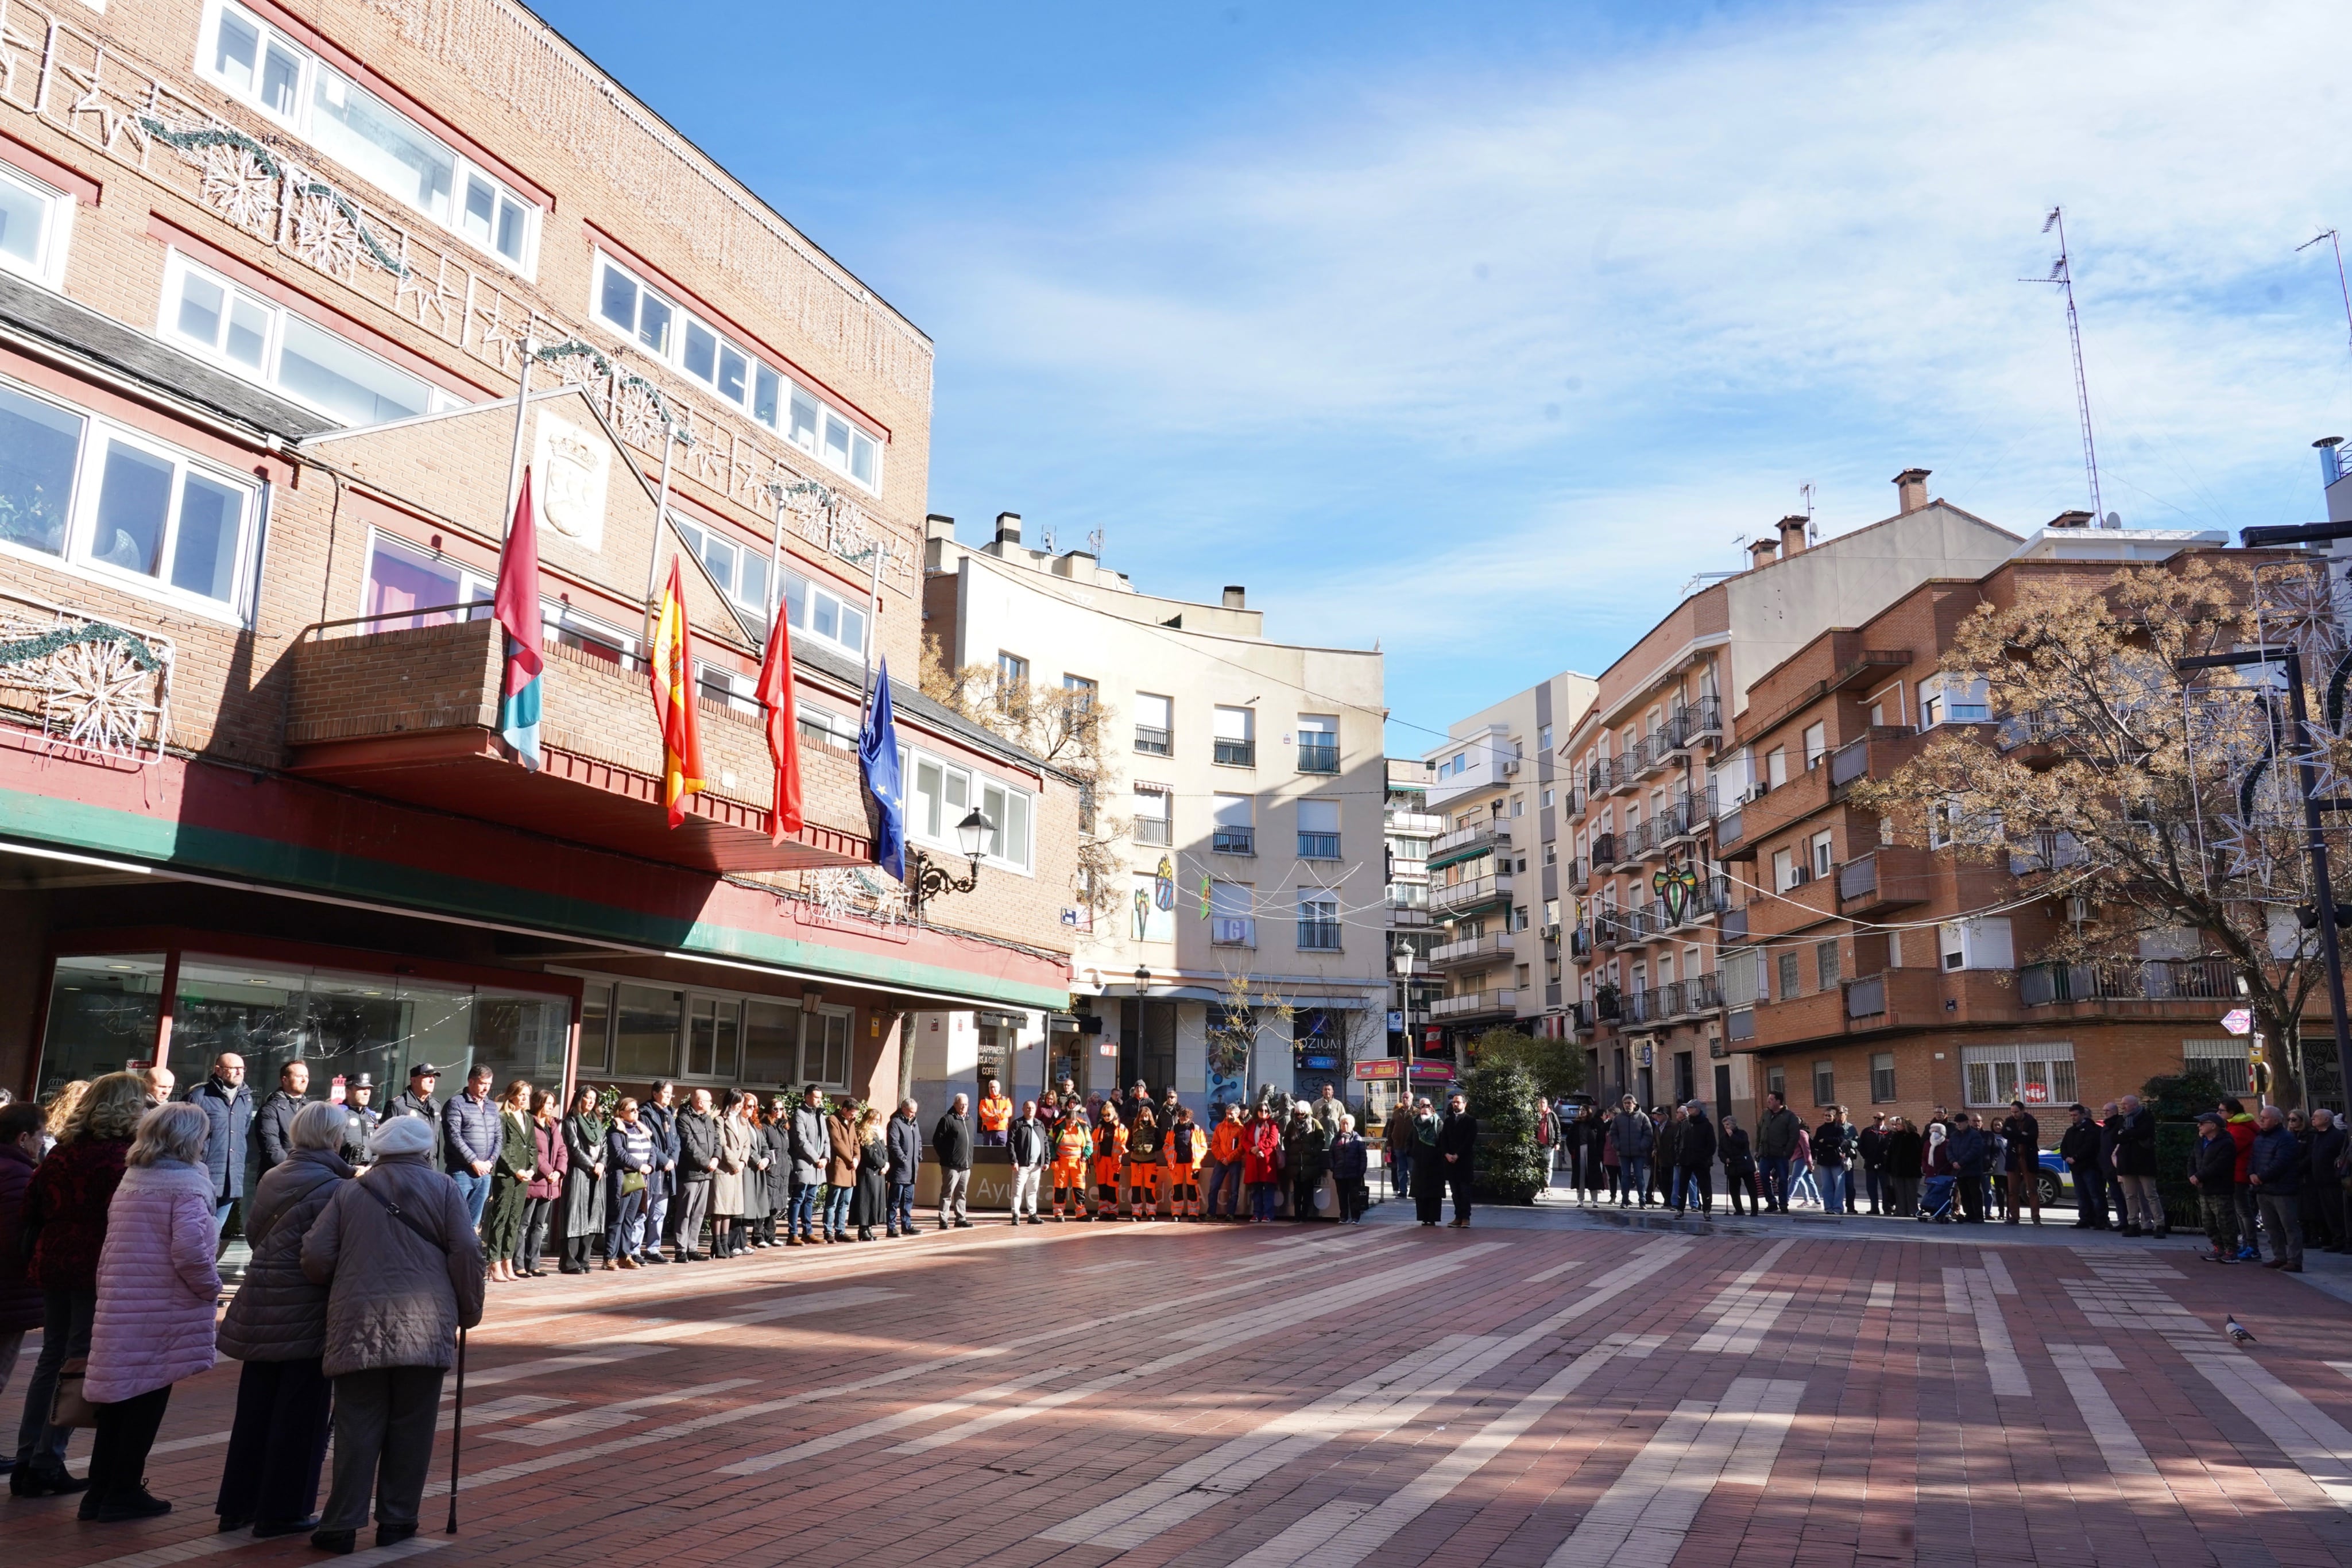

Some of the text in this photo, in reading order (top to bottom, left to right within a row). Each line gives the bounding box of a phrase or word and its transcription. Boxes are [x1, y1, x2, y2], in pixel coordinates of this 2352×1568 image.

[1229, 920, 1240, 940] G
[1105, 1033, 1111, 1042] 2
[978, 1044, 1005, 1054] HAPPINESS
[978, 1056, 984, 1064] IS
[988, 1056, 998, 1064] CUP
[999, 1057, 1005, 1065] OF
[982, 1067, 1000, 1075] COFFEE
